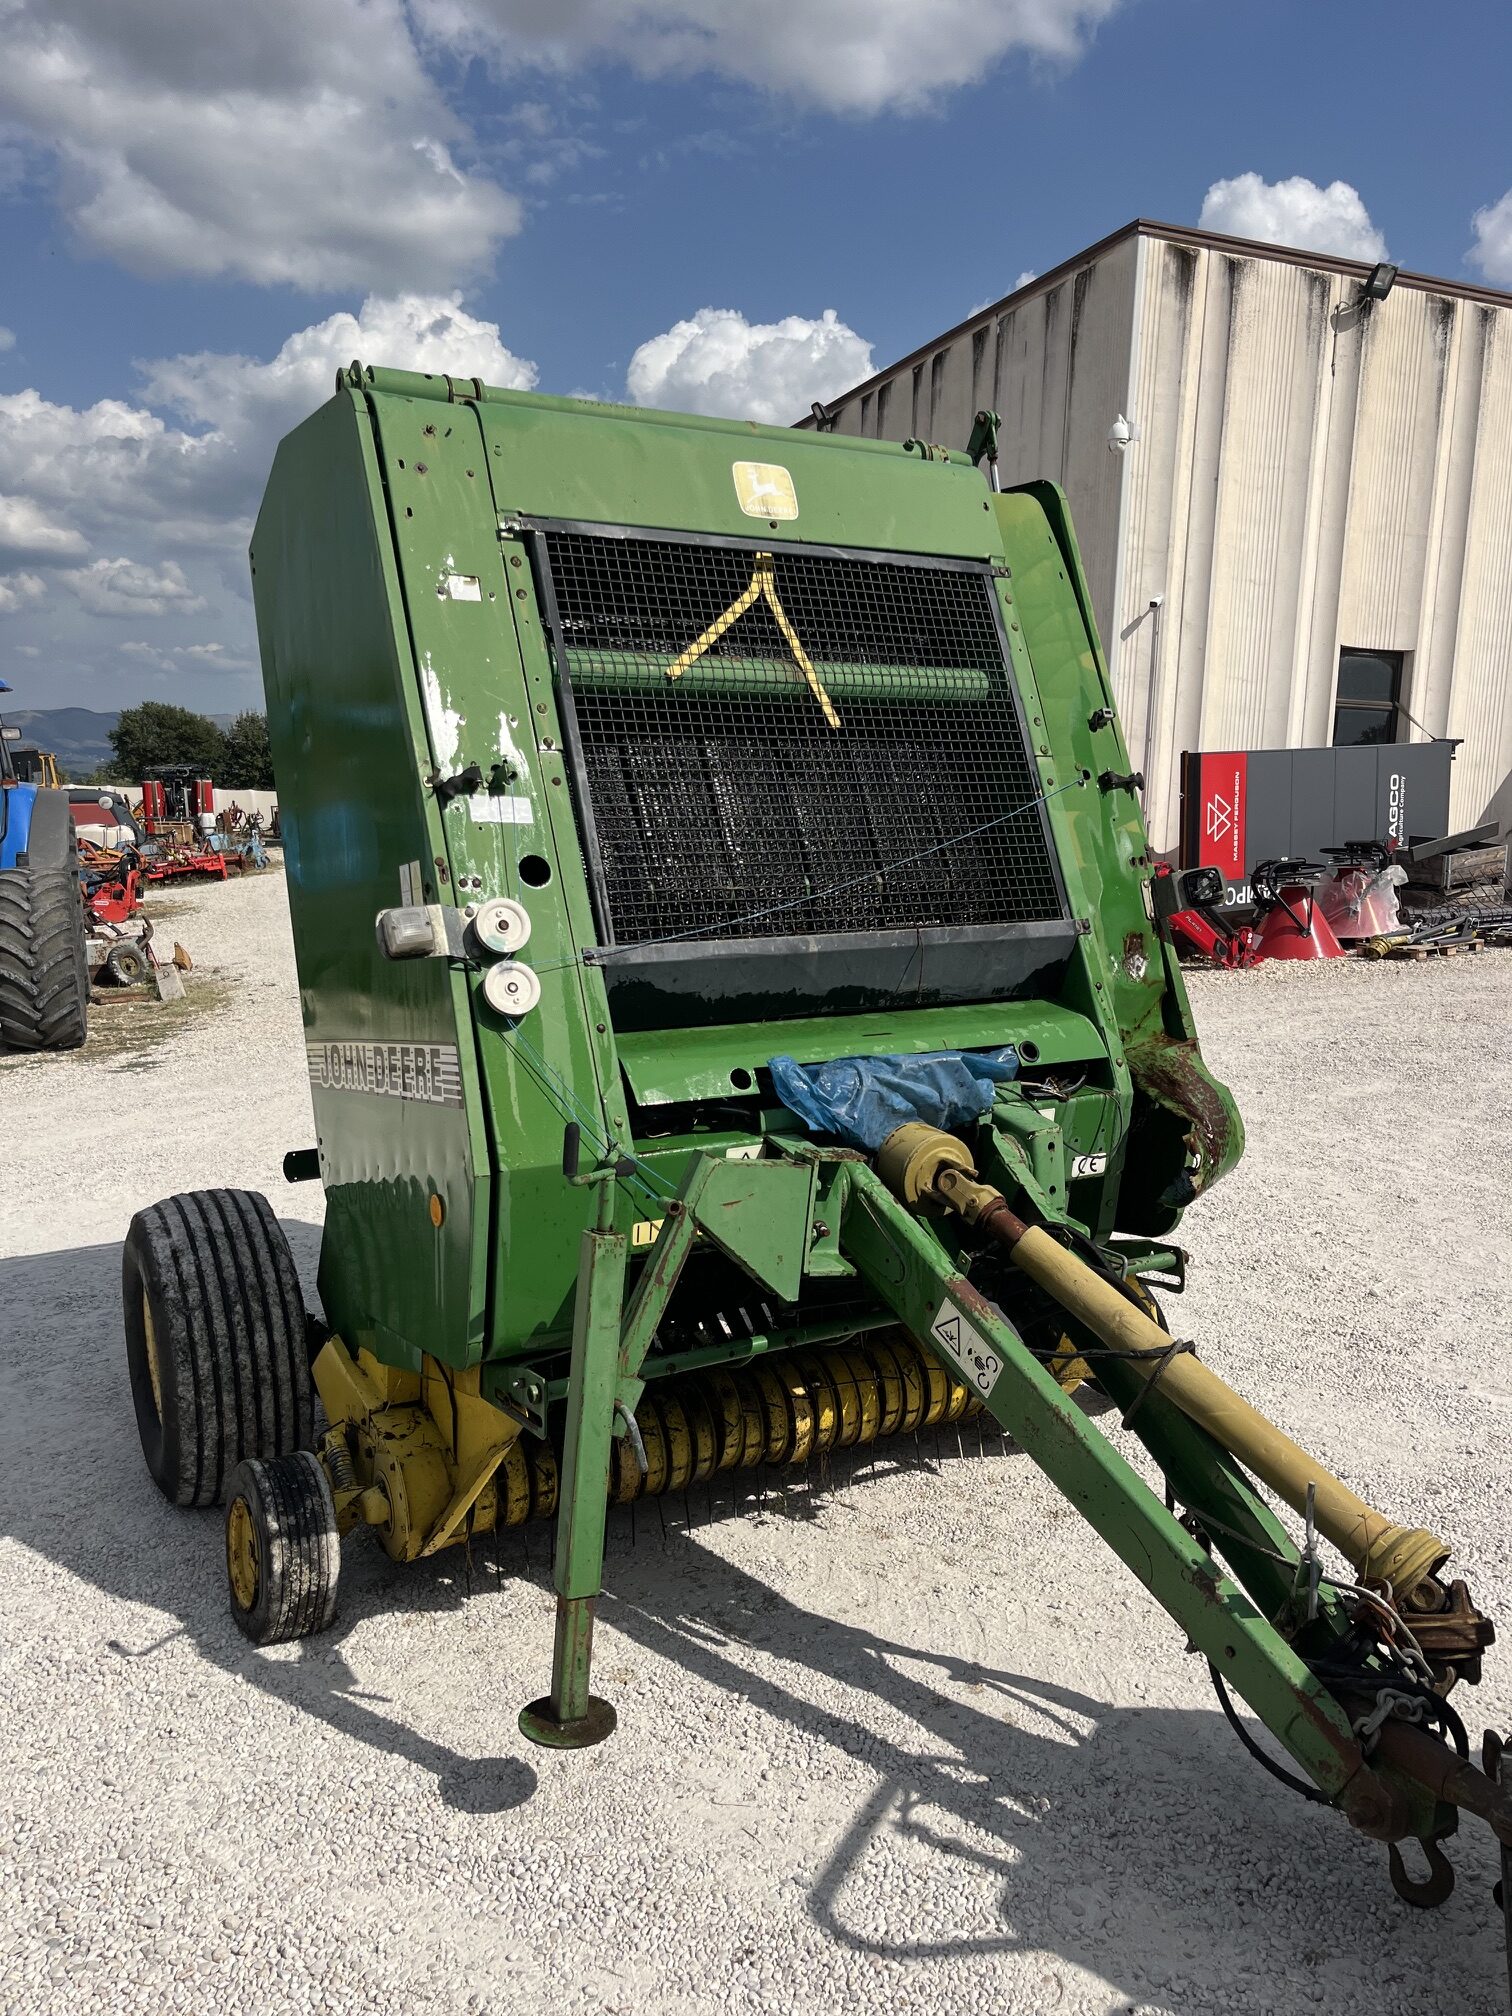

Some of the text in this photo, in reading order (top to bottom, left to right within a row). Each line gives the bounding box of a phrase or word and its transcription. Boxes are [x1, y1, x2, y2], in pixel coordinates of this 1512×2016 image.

[1389, 774, 1399, 837] AGCO
[320, 1045, 444, 1102] JOHN DEERE
[1078, 1157, 1097, 1174] CE
